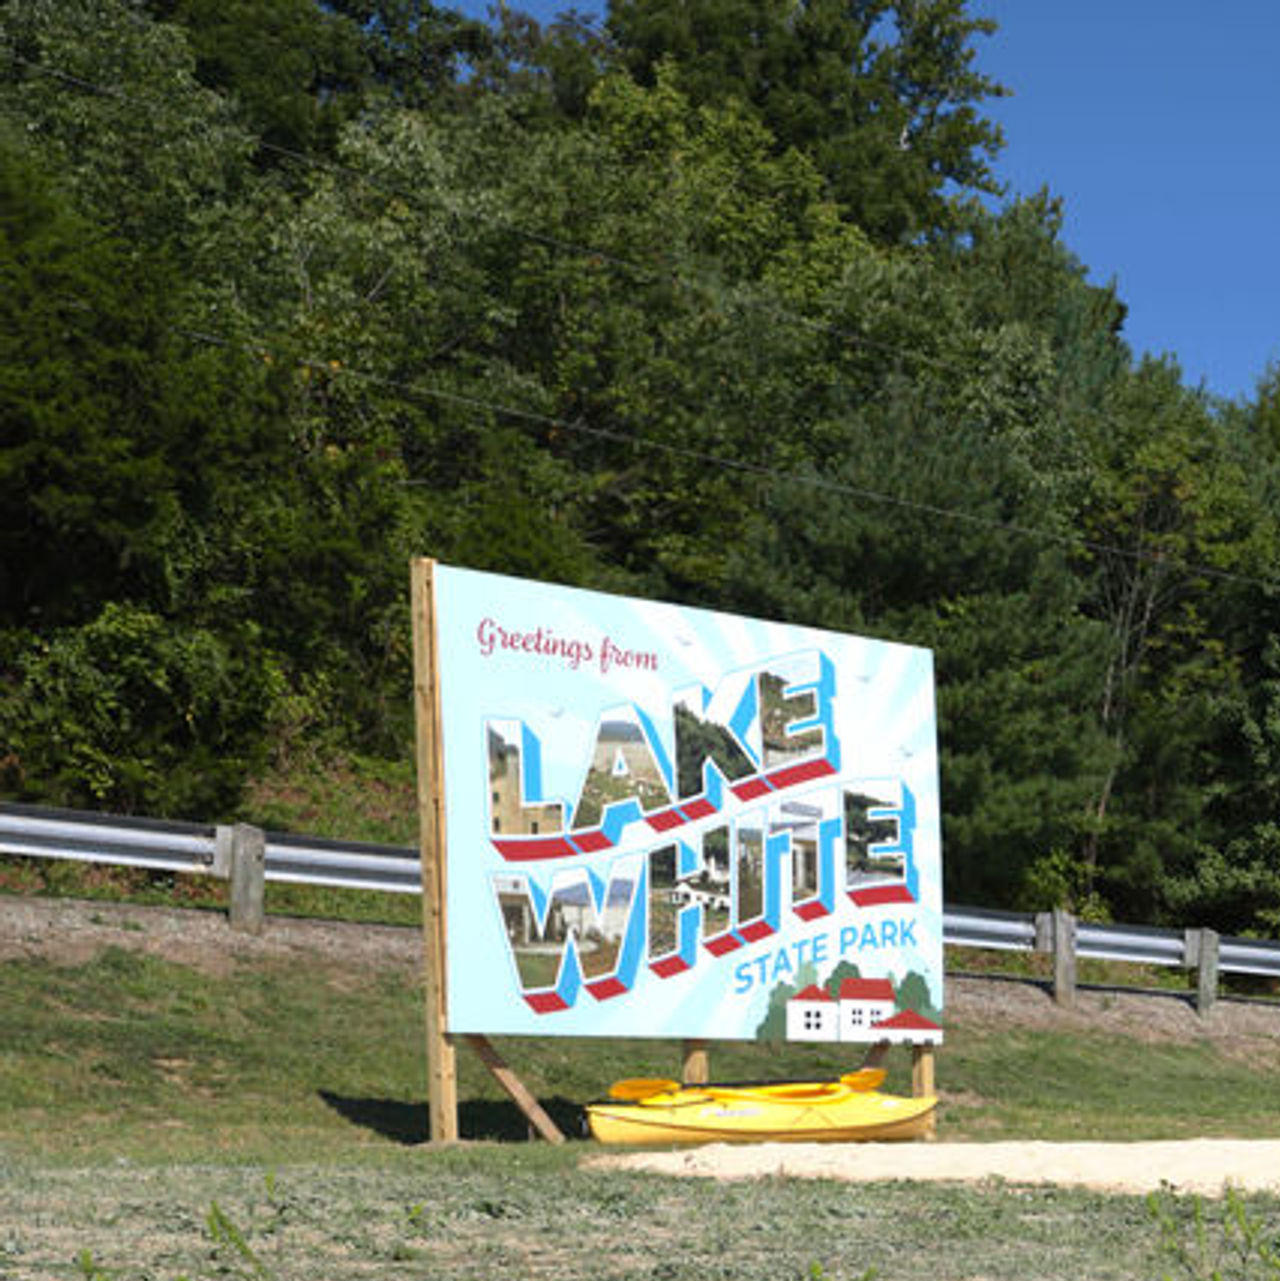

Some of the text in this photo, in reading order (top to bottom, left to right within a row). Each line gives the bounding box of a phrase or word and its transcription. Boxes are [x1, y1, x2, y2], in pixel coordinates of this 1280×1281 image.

[477, 617, 659, 674] Greetings from
[484, 648, 842, 862] LAKE
[488, 776, 918, 1016] WHITE
[733, 917, 917, 995] STATE PARK
